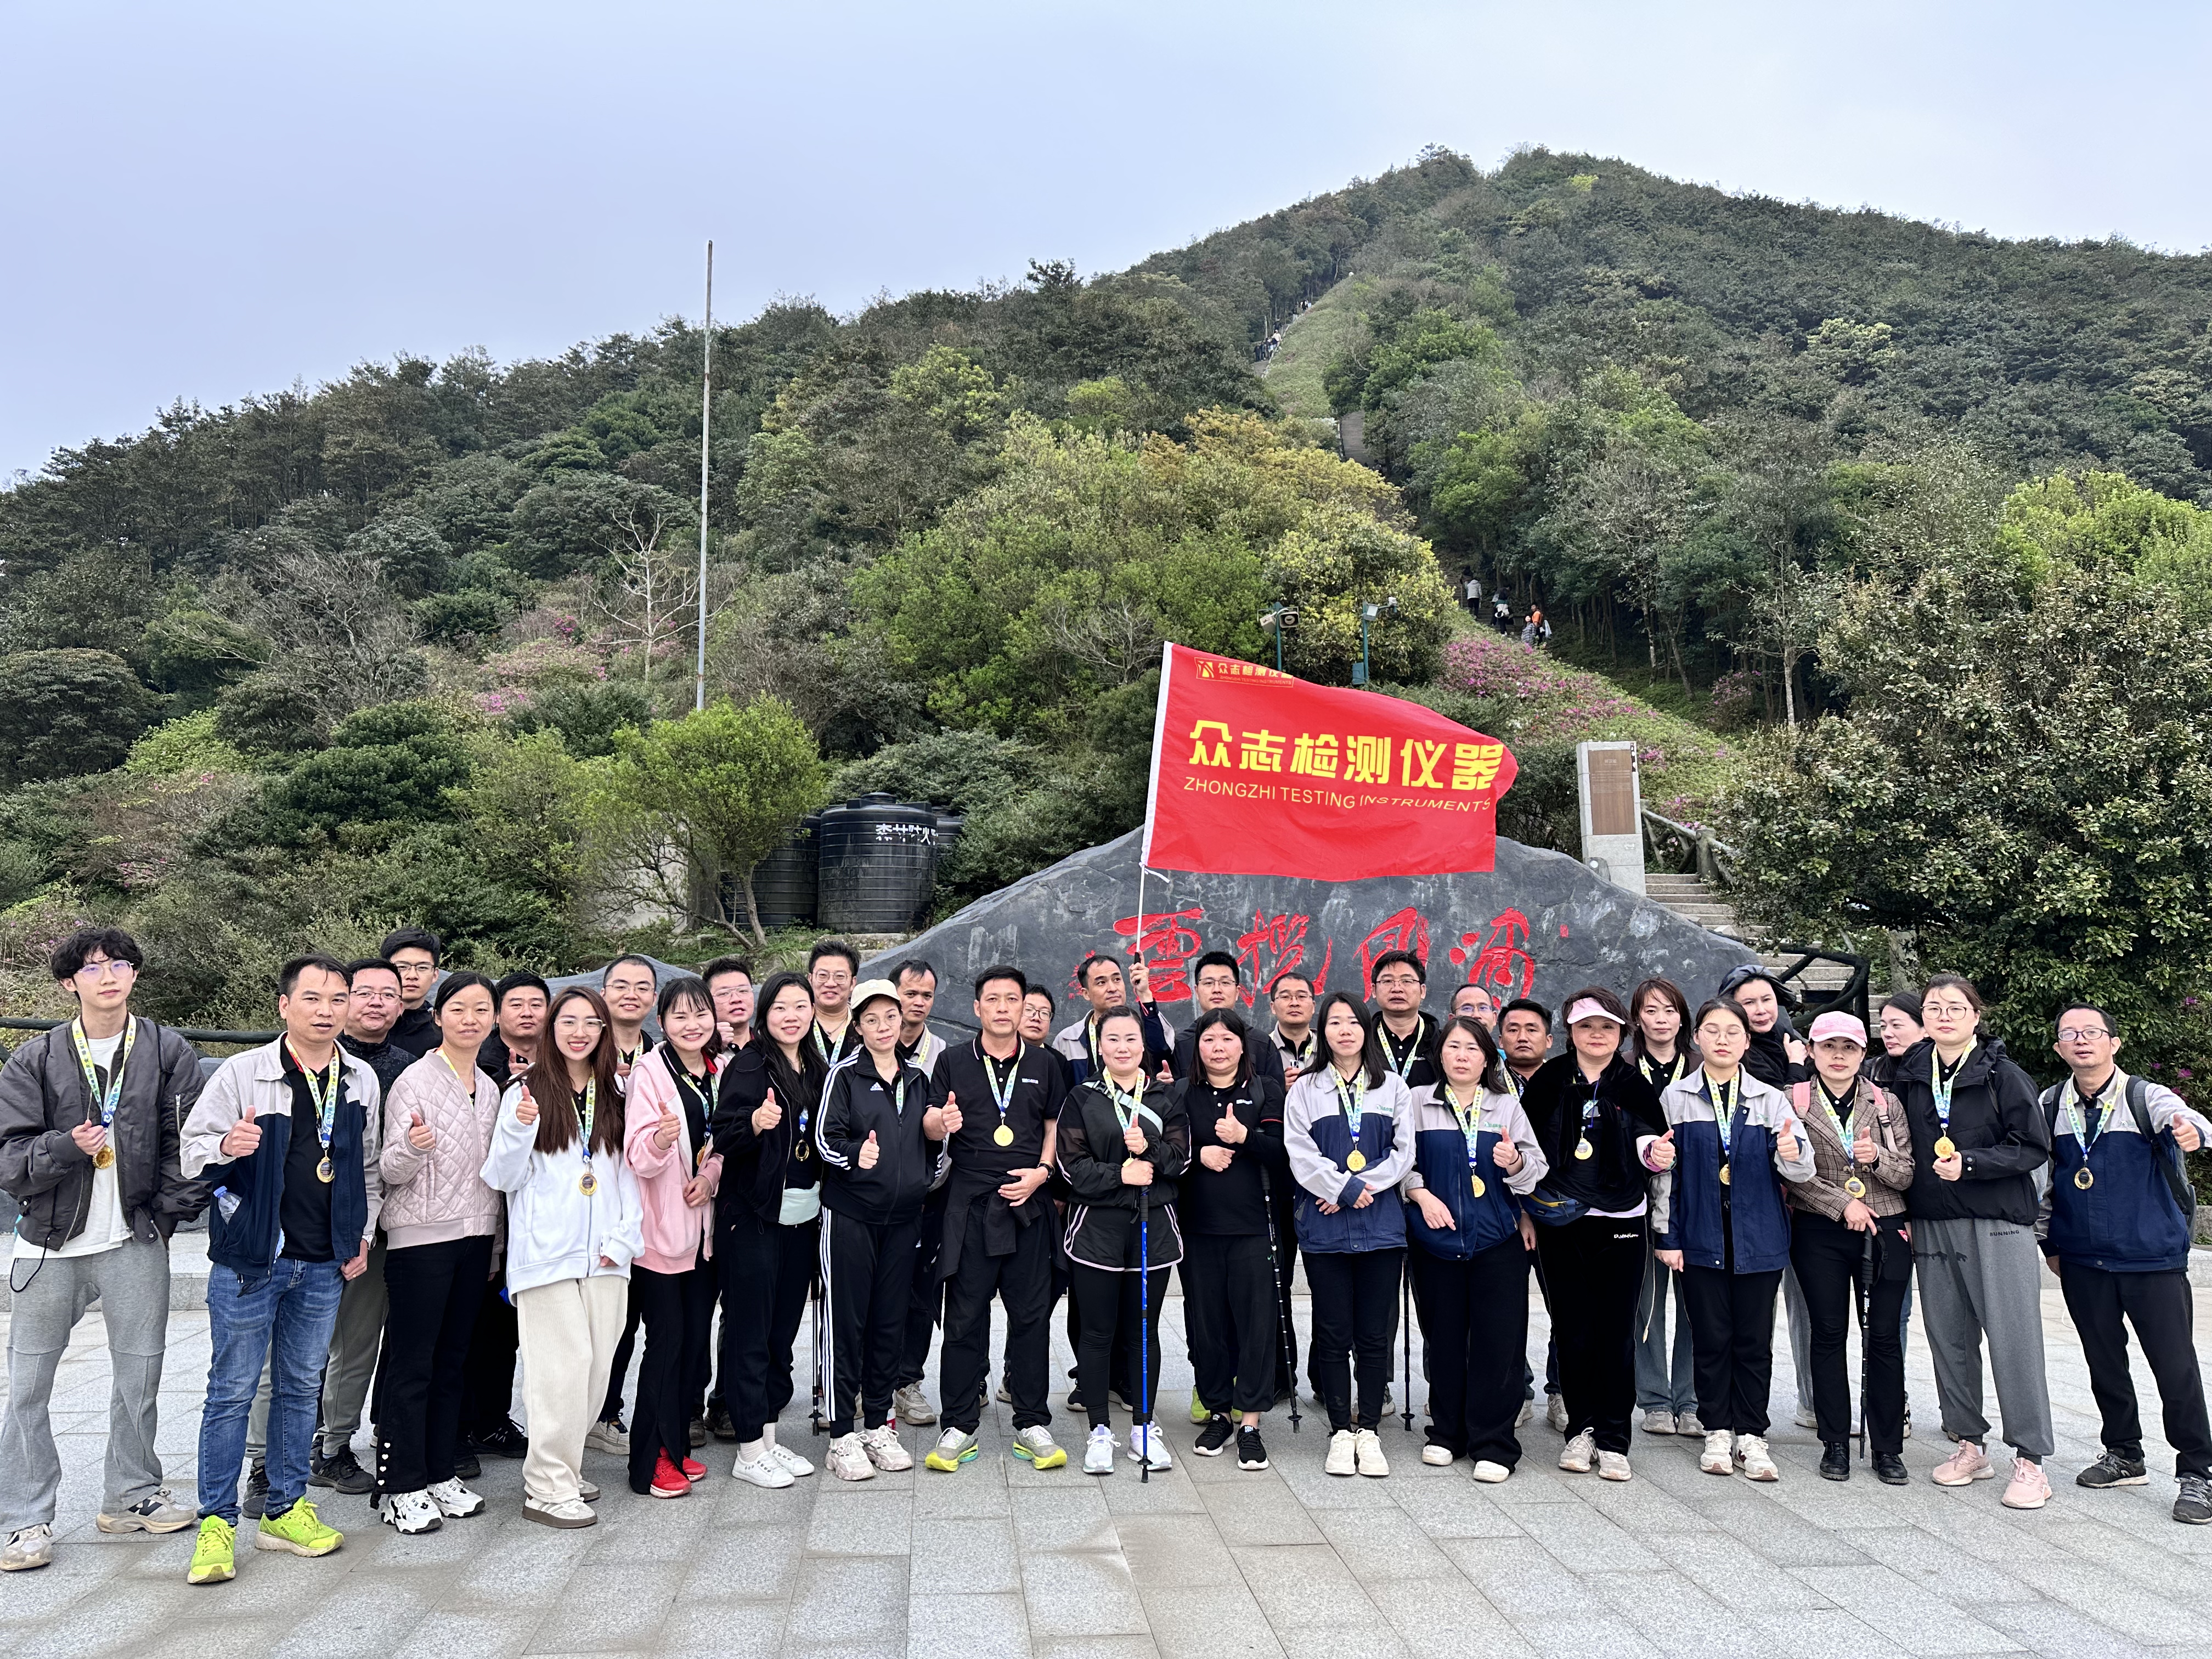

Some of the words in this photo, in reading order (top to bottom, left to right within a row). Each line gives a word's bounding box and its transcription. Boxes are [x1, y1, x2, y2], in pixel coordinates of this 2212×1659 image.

[1189, 720, 1504, 790] 众志检测仪器
[1184, 777, 1275, 799] ZHONGZHI
[1280, 787, 1355, 809] TESTING
[1359, 795, 1491, 812] INSTRUMENTS
